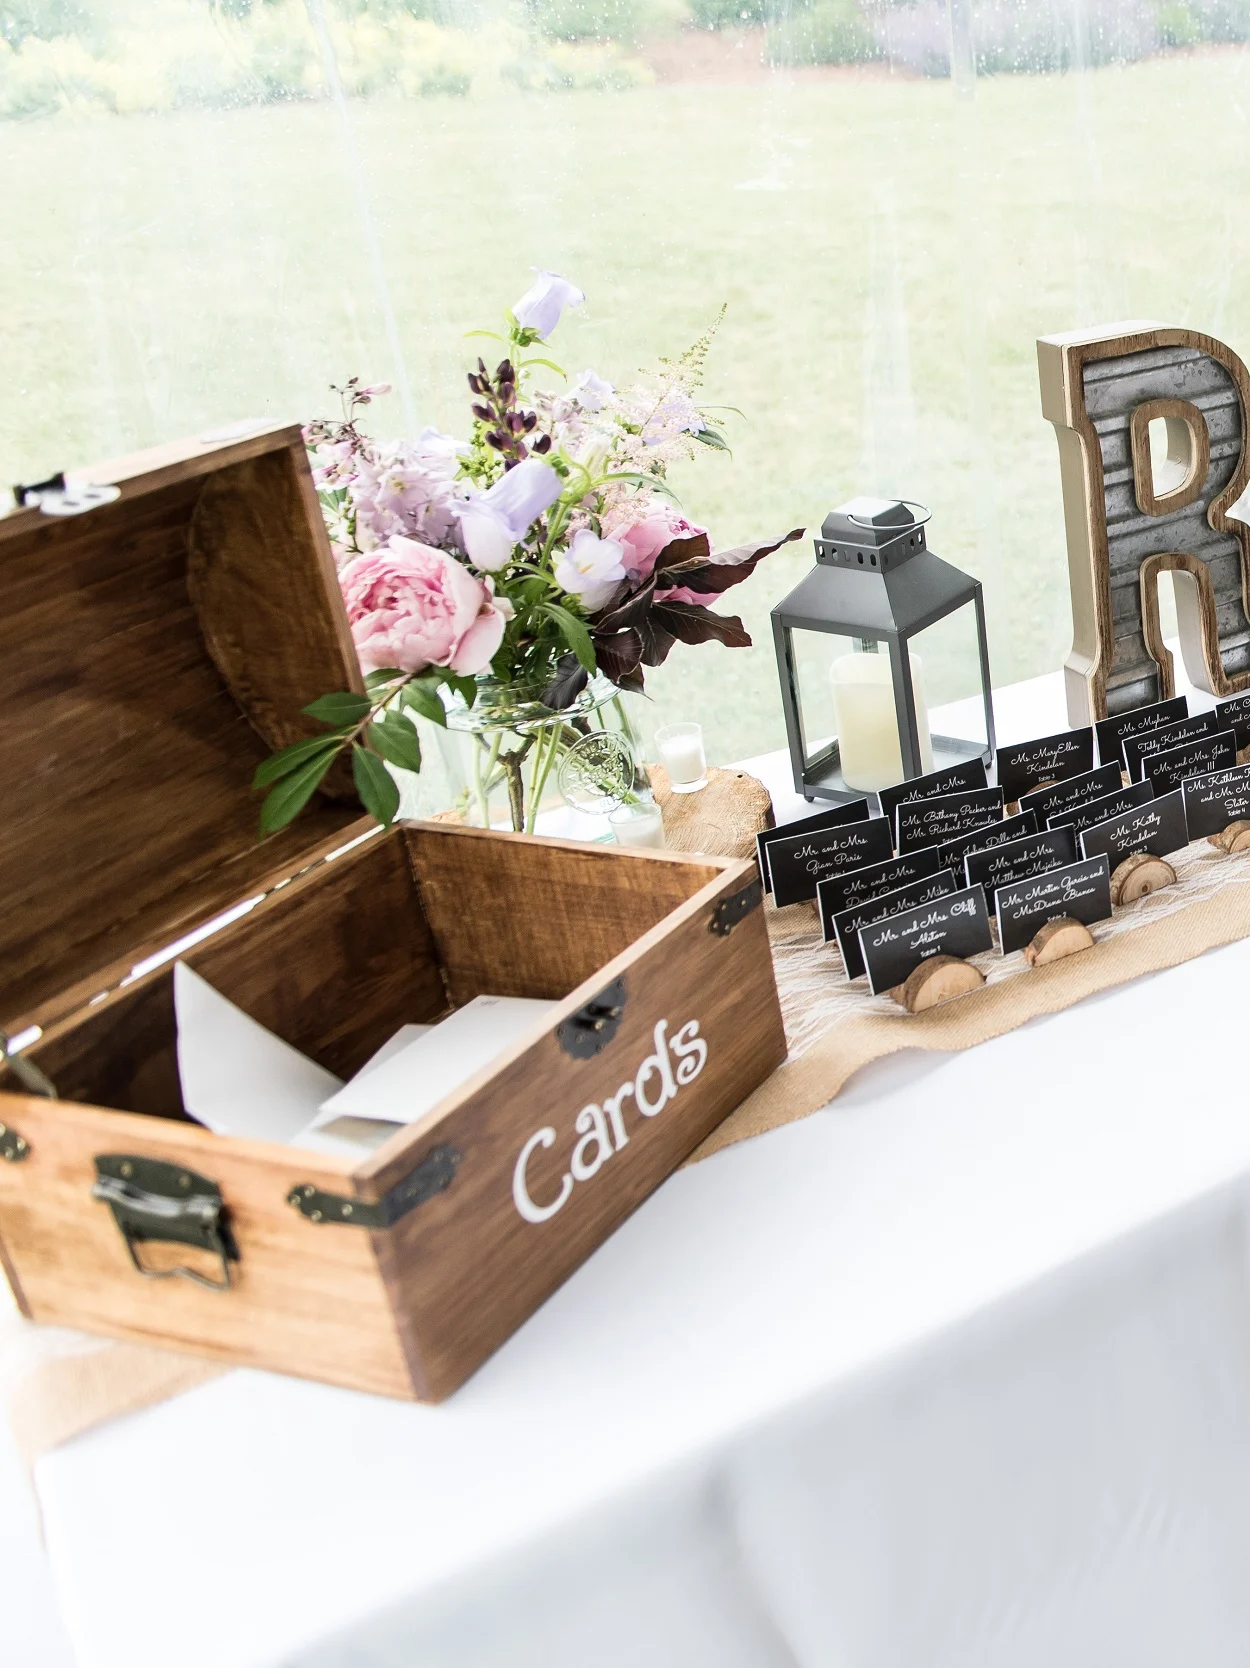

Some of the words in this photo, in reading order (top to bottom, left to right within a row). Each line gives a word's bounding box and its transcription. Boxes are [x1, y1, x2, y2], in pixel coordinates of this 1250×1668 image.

[1223, 702, 1241, 714] Ms.
[1230, 714, 1244, 724] and
[1118, 722, 1136, 735] Ms.
[1137, 739, 1161, 752] Teddy
[1159, 728, 1196, 746] Kindelan
[1195, 722, 1209, 735] and
[1010, 752, 1031, 766] Ms.
[1032, 742, 1080, 760] MaryEllen
[1026, 757, 1066, 775] Kindelan
[1153, 761, 1173, 775] Mr.
[1173, 756, 1188, 769] and
[1187, 750, 1210, 764] Mrs.
[1211, 743, 1231, 760] John
[1169, 767, 1207, 784] Kindelan
[1187, 779, 1206, 793] Ms.
[1207, 770, 1244, 788] Kathleen
[902, 789, 926, 803] Mr.
[926, 783, 942, 797] and
[942, 776, 967, 790] Mrs.
[1042, 795, 1064, 811] Mr.
[1065, 788, 1080, 802] and
[1080, 780, 1104, 796] Mrs.
[1200, 791, 1215, 803] and
[1214, 786, 1235, 800] Mr.
[901, 814, 922, 828] Ms.
[923, 809, 960, 824] Bethany
[987, 800, 1002, 811] and
[1074, 815, 1093, 831] Mr.
[1094, 808, 1109, 822] and
[1109, 800, 1134, 815] Mrs.
[1109, 824, 1131, 841] Ms.
[1131, 811, 1162, 831] Kathy
[906, 828, 927, 840] Mr.
[928, 820, 962, 836] Richard
[1116, 829, 1158, 852] Kindelan
[794, 844, 820, 860] Mr.
[821, 839, 840, 854] and
[840, 834, 869, 849] Mrs.
[939, 852, 961, 868] Mr.
[1011, 824, 1028, 839] and
[988, 855, 1012, 872] Mr.
[1012, 850, 1030, 864] and
[1029, 843, 1056, 860] Mrs.
[805, 859, 834, 876] Gian
[834, 852, 863, 866] Paris
[842, 879, 869, 895] Mr.
[869, 872, 888, 887] and
[887, 865, 917, 881] Mrs.
[983, 868, 1026, 890] Matthew
[1001, 893, 1024, 909] Mr.
[1024, 882, 1061, 901] Martin
[1060, 875, 1090, 891] Garcia
[1089, 865, 1105, 879] and
[844, 916, 870, 934] Mr.
[871, 907, 890, 922] and
[889, 897, 919, 915] Mrs.
[919, 884, 951, 903] Mike
[873, 928, 899, 947] Mr.
[900, 919, 920, 937] and
[919, 910, 949, 930] Mrs.
[949, 897, 977, 917] Cliff
[511, 1018, 709, 1224] Cards
